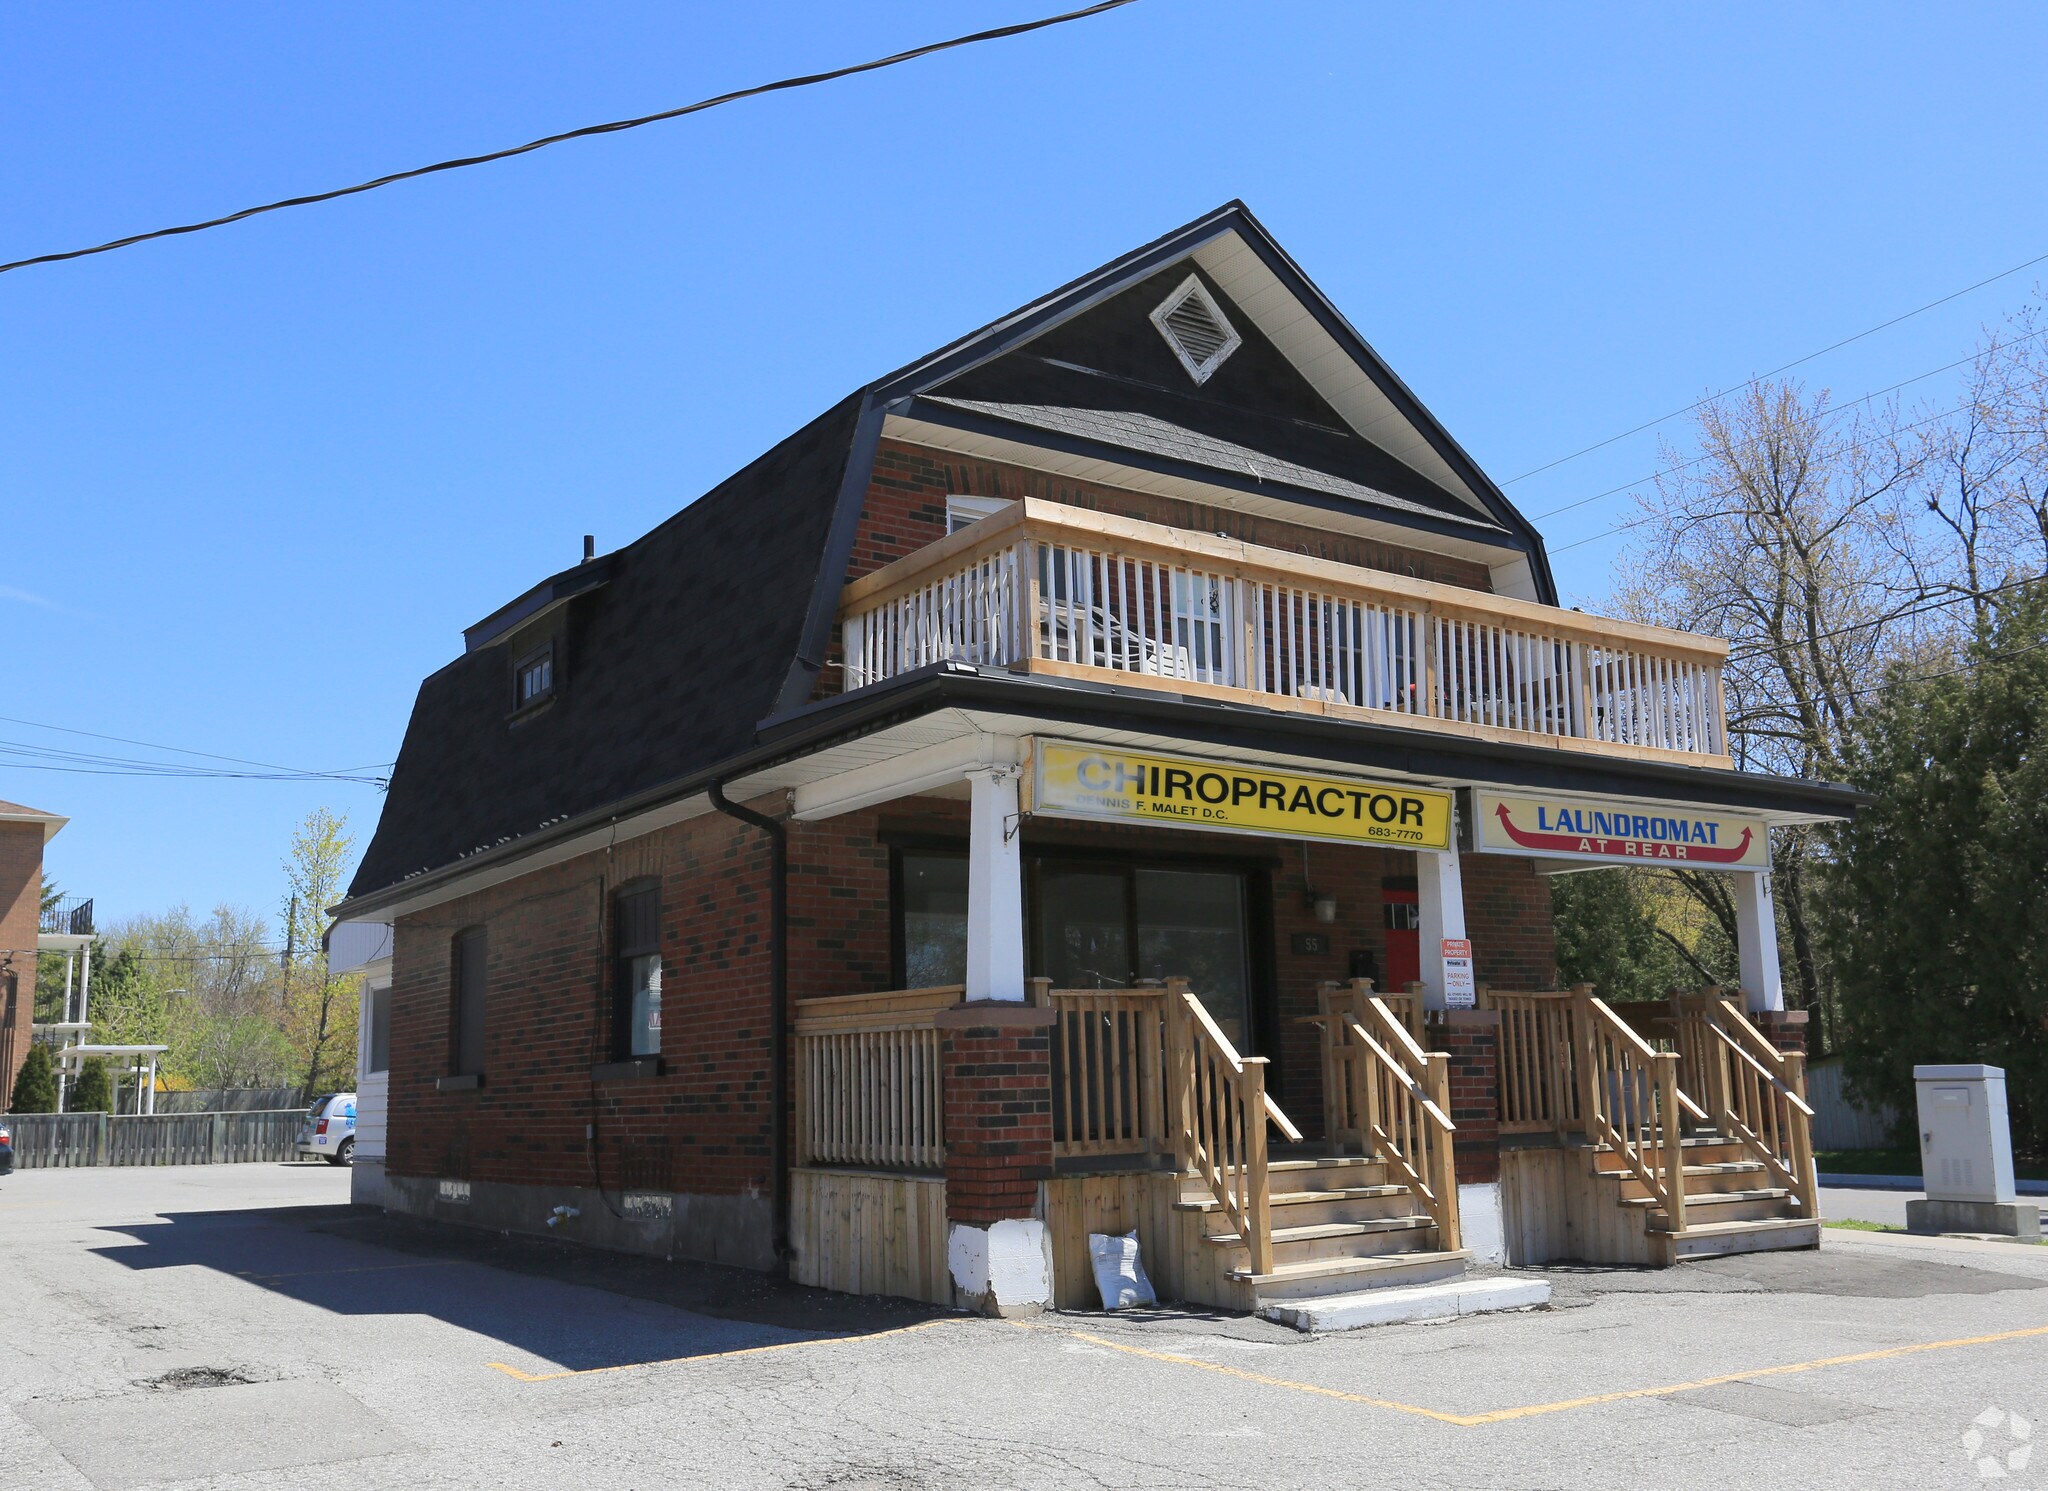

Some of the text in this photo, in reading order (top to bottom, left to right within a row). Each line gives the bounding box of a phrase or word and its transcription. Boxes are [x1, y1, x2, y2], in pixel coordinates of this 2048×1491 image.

[1076, 757, 1425, 827] CHIROPRACTOR
[1076, 794, 1228, 820] DENNIS F. MALET D.C.
[1368, 826, 1423, 841] 683-7770
[1538, 806, 1719, 845] LAUNDROMAT
[1578, 838, 1688, 859] AT REAR
[1447, 972, 1469, 980] PARKING
